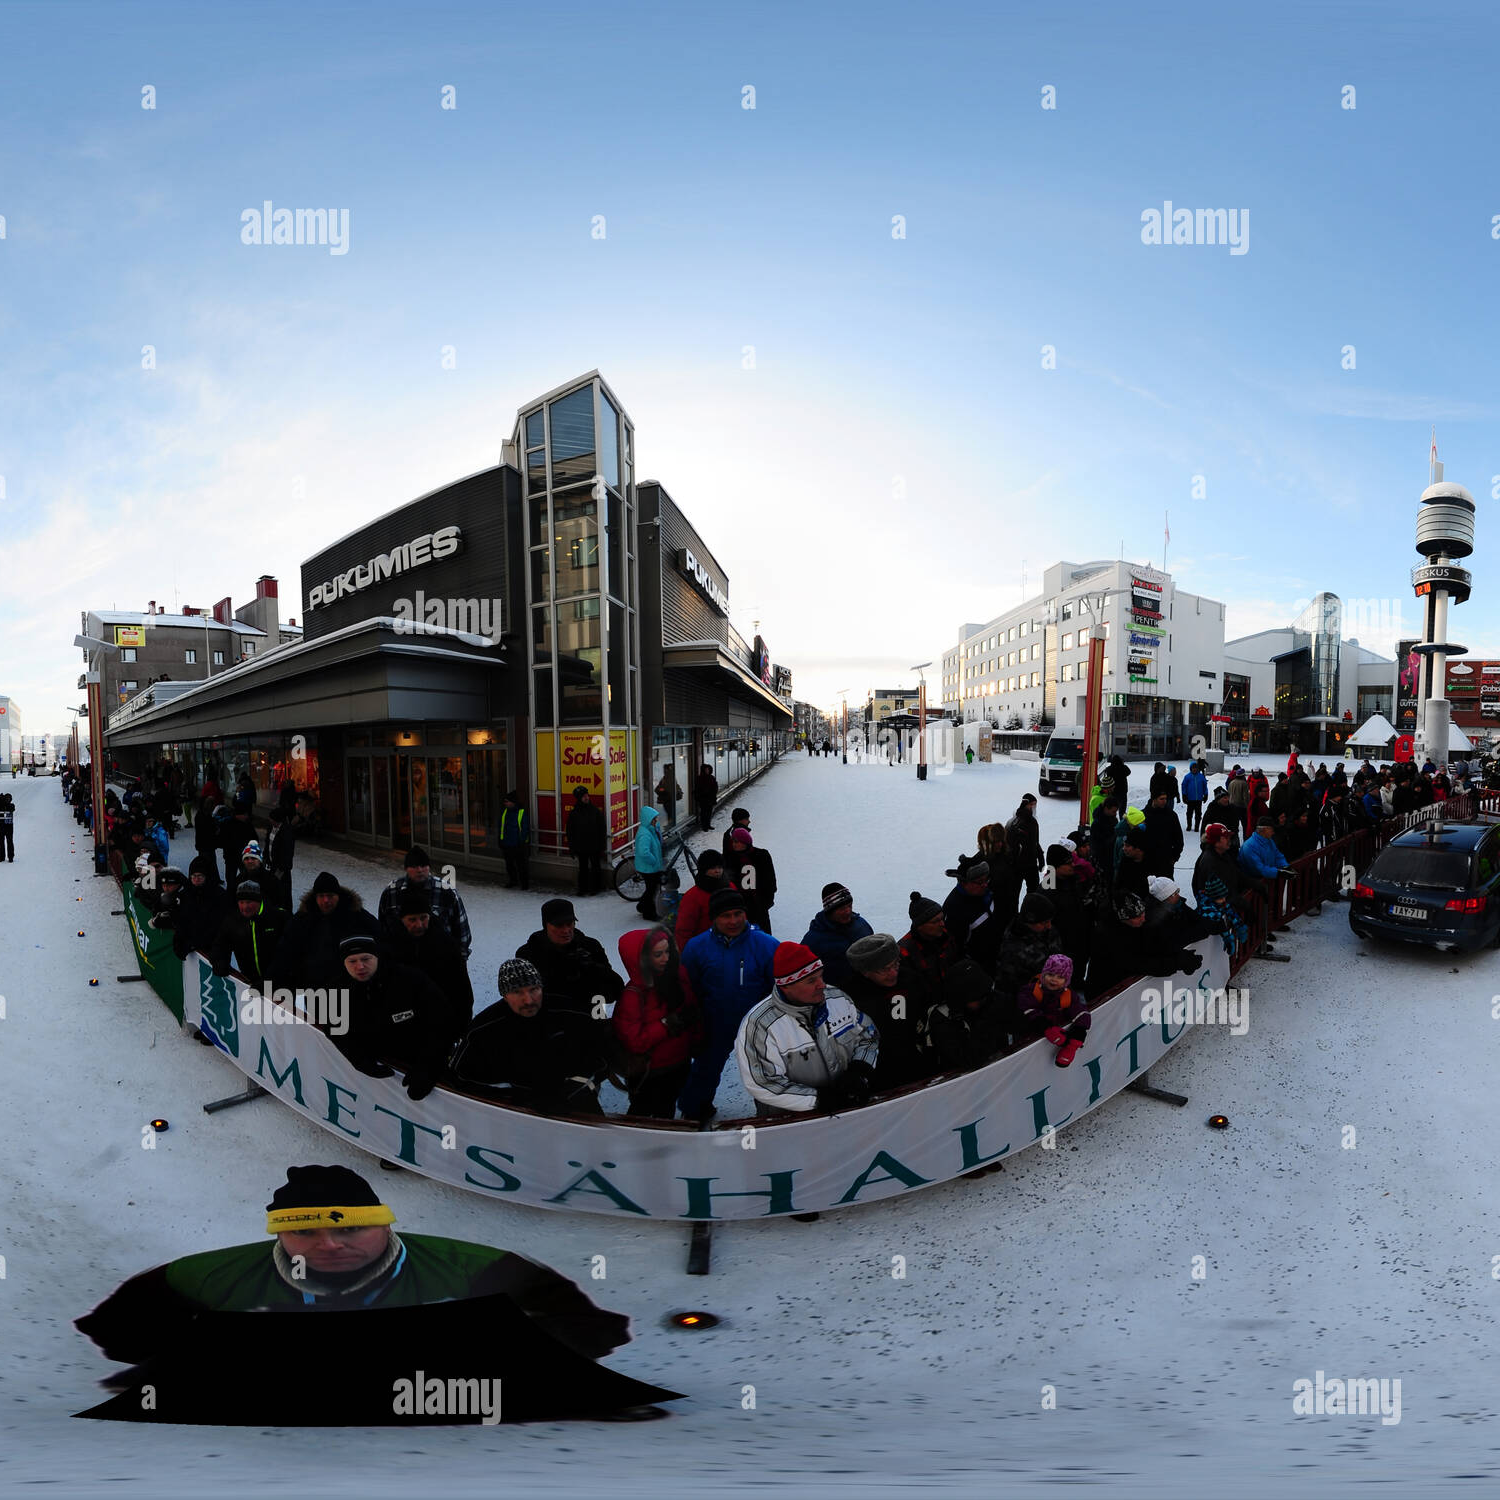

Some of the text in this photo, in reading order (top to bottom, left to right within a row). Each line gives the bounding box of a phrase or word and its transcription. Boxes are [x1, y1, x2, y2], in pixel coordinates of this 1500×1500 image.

[309, 526, 462, 611] PUKUMIES
[562, 747, 603, 766] Sale
[609, 746, 626, 765] Sale
[566, 775, 581, 784] 100
[256, 969, 1211, 1218] METSÄHALLITUS
